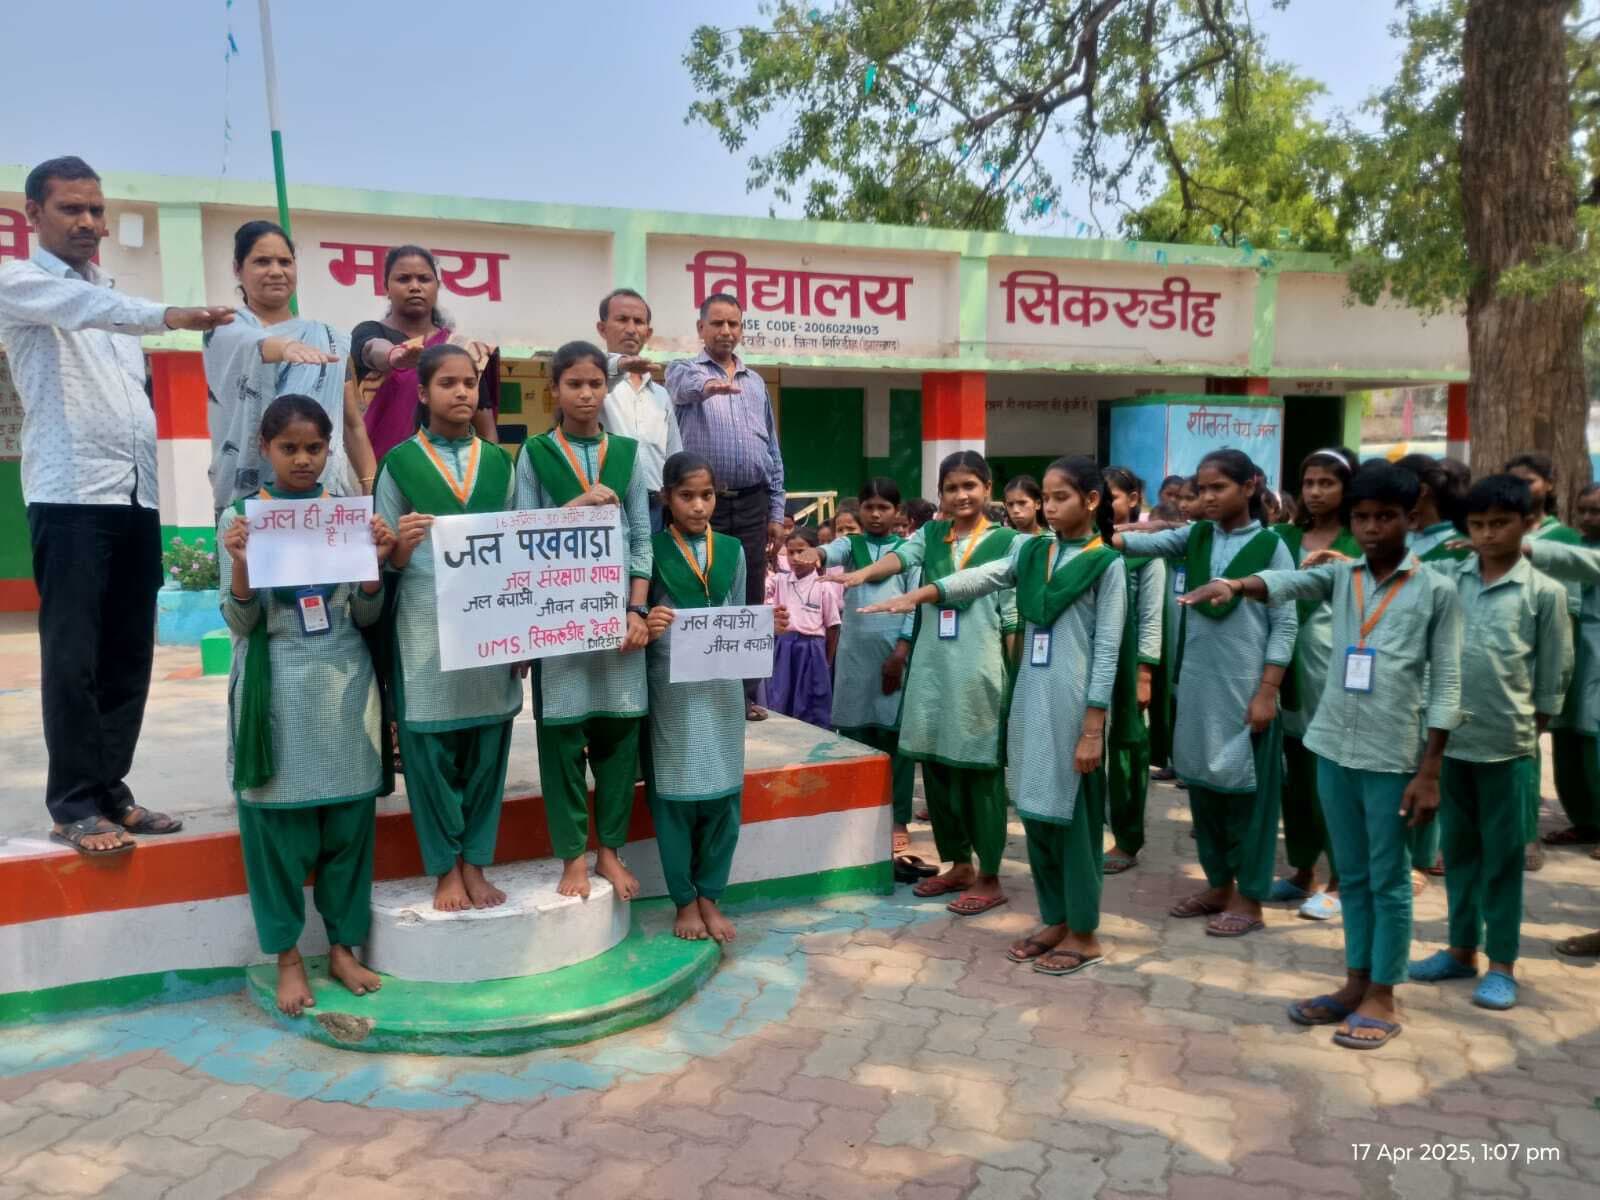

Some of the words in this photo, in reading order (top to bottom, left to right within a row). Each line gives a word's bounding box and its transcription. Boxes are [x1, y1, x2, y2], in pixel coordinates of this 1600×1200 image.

[320, 241, 510, 302] मय
[686, 251, 914, 321] विद्यालय
[1187, 405, 1233, 438] शीतल
[1233, 419, 1253, 438] पेय
[1255, 423, 1279, 438] जल
[254, 509, 295, 529] जल
[303, 503, 322, 529] ही
[325, 504, 367, 525] जीवन
[589, 510, 616, 522] 2025
[444, 533, 504, 568] जल
[516, 526, 615, 562] पखवाड़ा
[503, 571, 530, 591] जल
[537, 565, 586, 588] संरक्षण
[463, 594, 492, 612] जल
[536, 598, 574, 617] जीवन
[590, 616, 621, 637] देवरी
[680, 615, 709, 631] जल
[704, 635, 740, 655] जीवन
